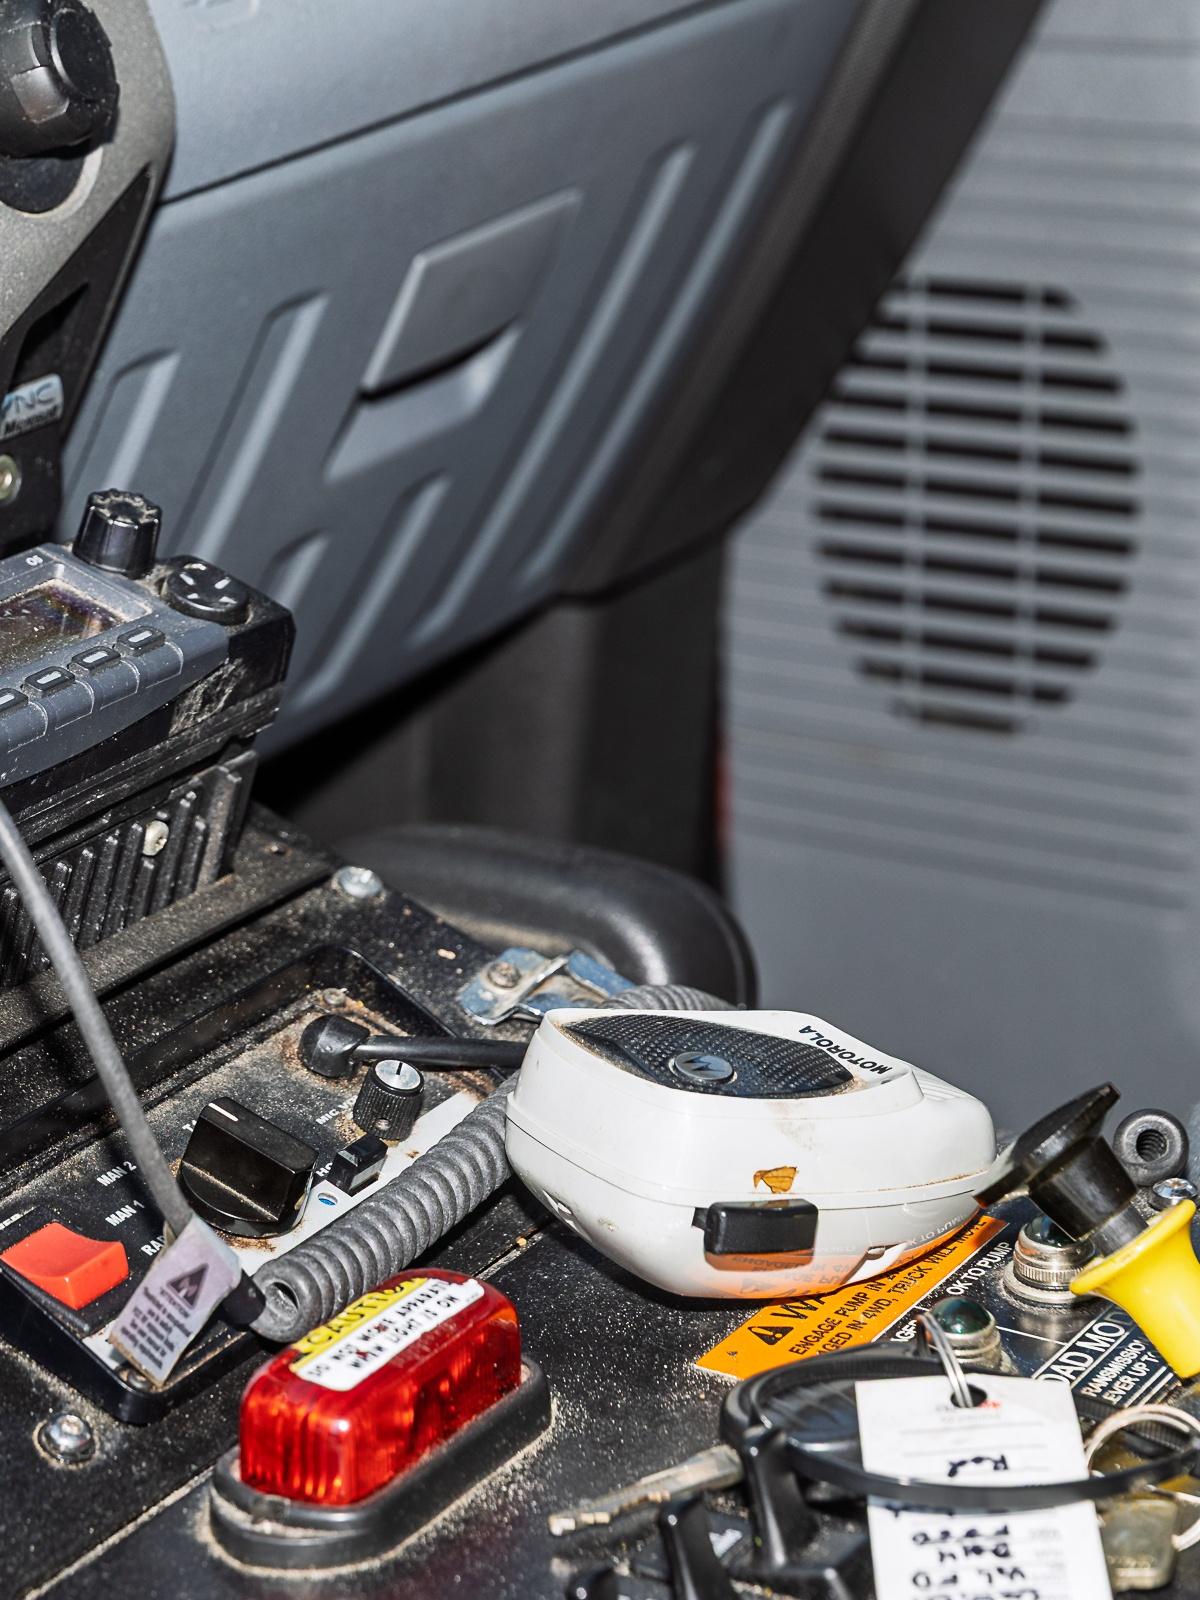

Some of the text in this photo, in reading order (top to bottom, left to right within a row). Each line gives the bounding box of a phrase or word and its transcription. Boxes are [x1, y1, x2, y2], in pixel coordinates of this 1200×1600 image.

[799, 1025, 892, 1074] MOTOROLA
[316, 1110, 339, 1125] MIC
[97, 1160, 137, 1187] MAN 2
[105, 1200, 145, 1226] MAN 1
[946, 1242, 1012, 1296] OK TO PUMP
[788, 1317, 842, 1355] ENGAGE
[834, 1291, 870, 1318] PUMP
[865, 1281, 886, 1293] IN
[846, 1319, 868, 1332] IN
[862, 1297, 899, 1320] 4WD,
[887, 1265, 933, 1295] TRUCK
[1076, 1311, 1135, 1352] MOD
[1081, 1338, 1148, 1397] RANSMISSIO
[1101, 1374, 1141, 1405] EVER
[1126, 1360, 1150, 1378] UP
